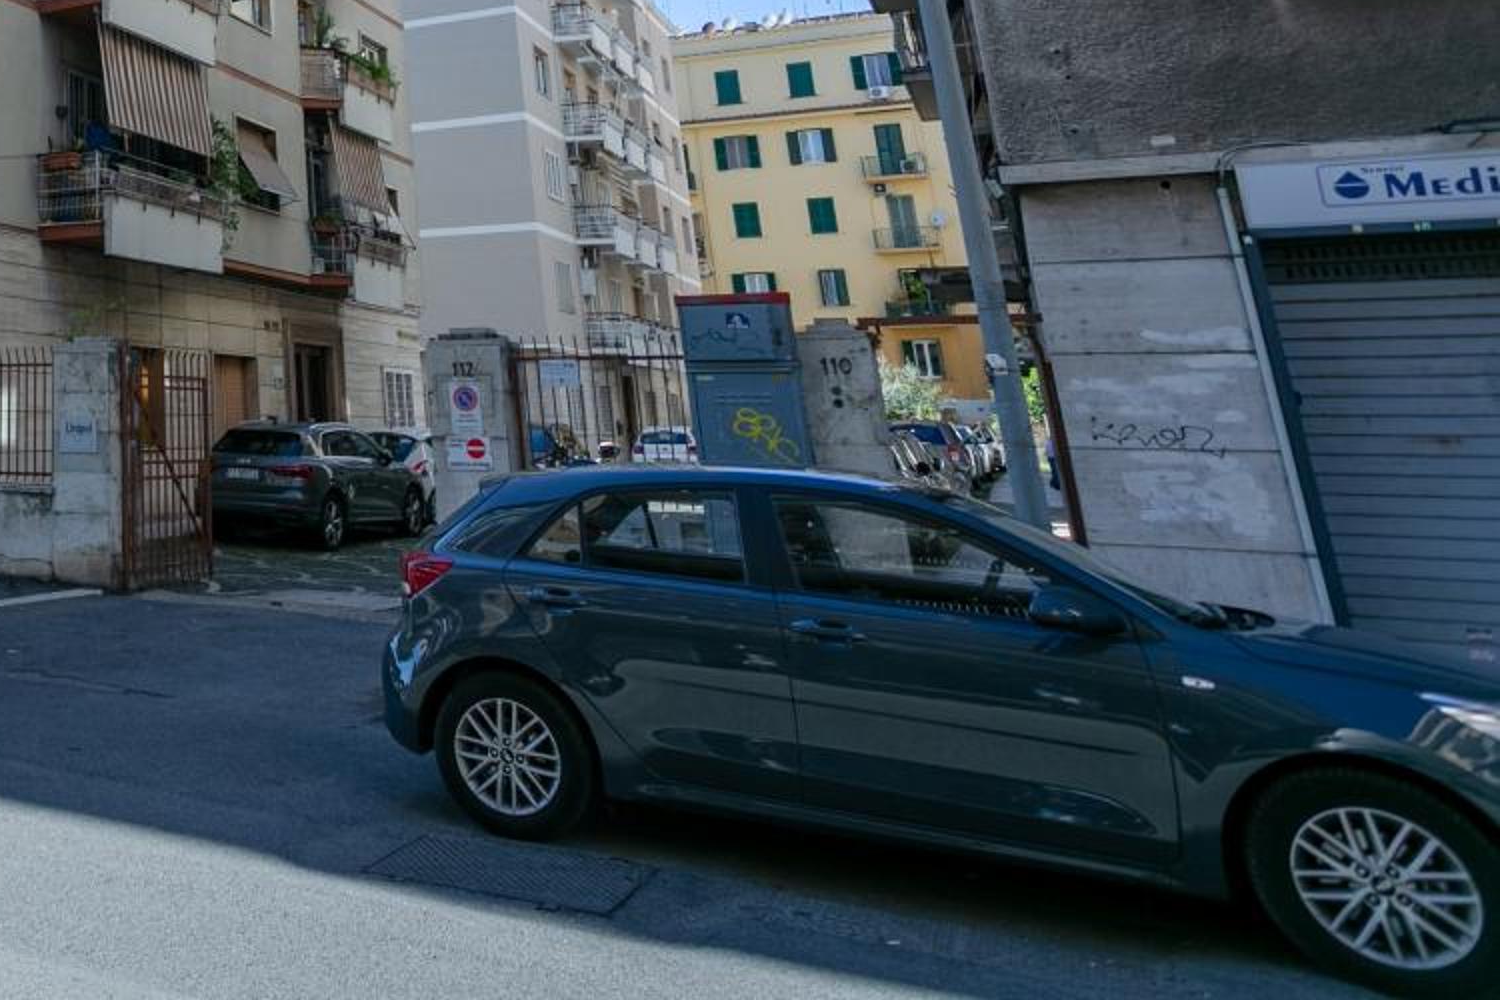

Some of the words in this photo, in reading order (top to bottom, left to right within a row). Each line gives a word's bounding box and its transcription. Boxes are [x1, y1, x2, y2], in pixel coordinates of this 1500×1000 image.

[1383, 166, 1500, 199] Medi
[452, 361, 475, 377] 112
[820, 356, 852, 375] 110
